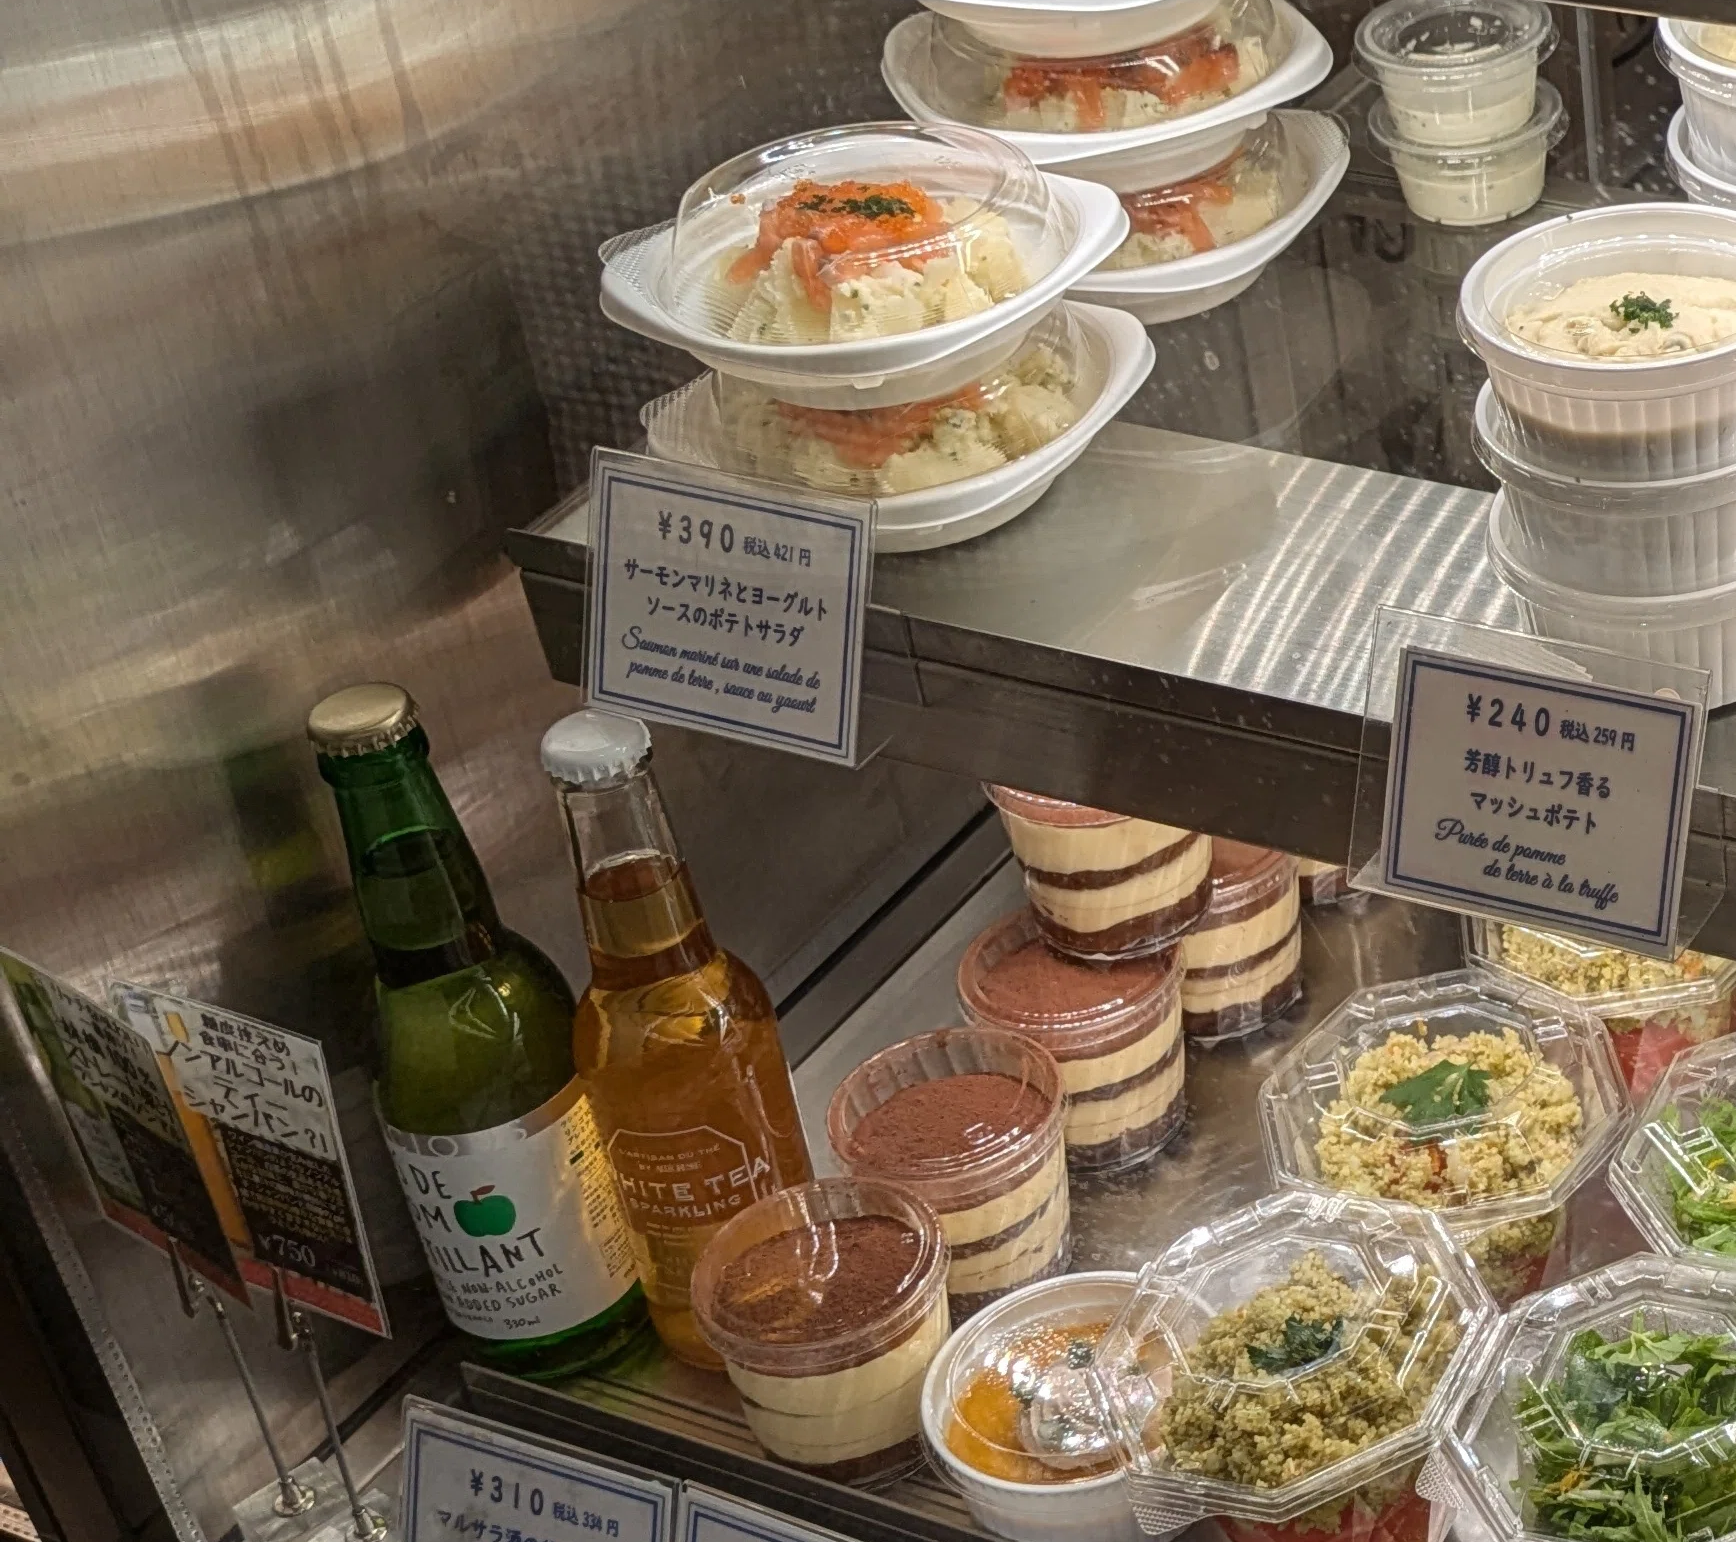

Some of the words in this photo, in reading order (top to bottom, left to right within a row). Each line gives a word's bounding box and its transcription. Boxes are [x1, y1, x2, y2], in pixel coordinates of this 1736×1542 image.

[658, 510, 734, 553] ¥390
[624, 558, 827, 622] サーモンマリネとヨーグルト
[647, 596, 805, 647] ソースのポテトサラダ
[671, 666, 685, 683] de
[806, 671, 821, 689] de
[1466, 694, 1550, 736] ¥240
[1464, 748, 1611, 799] 芳醇トリュフ香る
[1470, 791, 1597, 834] マッシュポテト
[1435, 818, 1488, 847] Purée
[1493, 835, 1510, 853] de
[1510, 843, 1566, 865] pomme
[1483, 861, 1501, 878] de
[1505, 864, 1539, 886] terre
[1542, 872, 1554, 889] à
[1558, 875, 1574, 894] la
[1578, 881, 1619, 910] truffe
[620, 1173, 695, 1202] HITE
[704, 1156, 770, 1196] TEA
[629, 1194, 741, 1218] SPARKLING
[504, 1283, 562, 1309] SUGAR
[470, 1468, 544, 1516] ¥310
